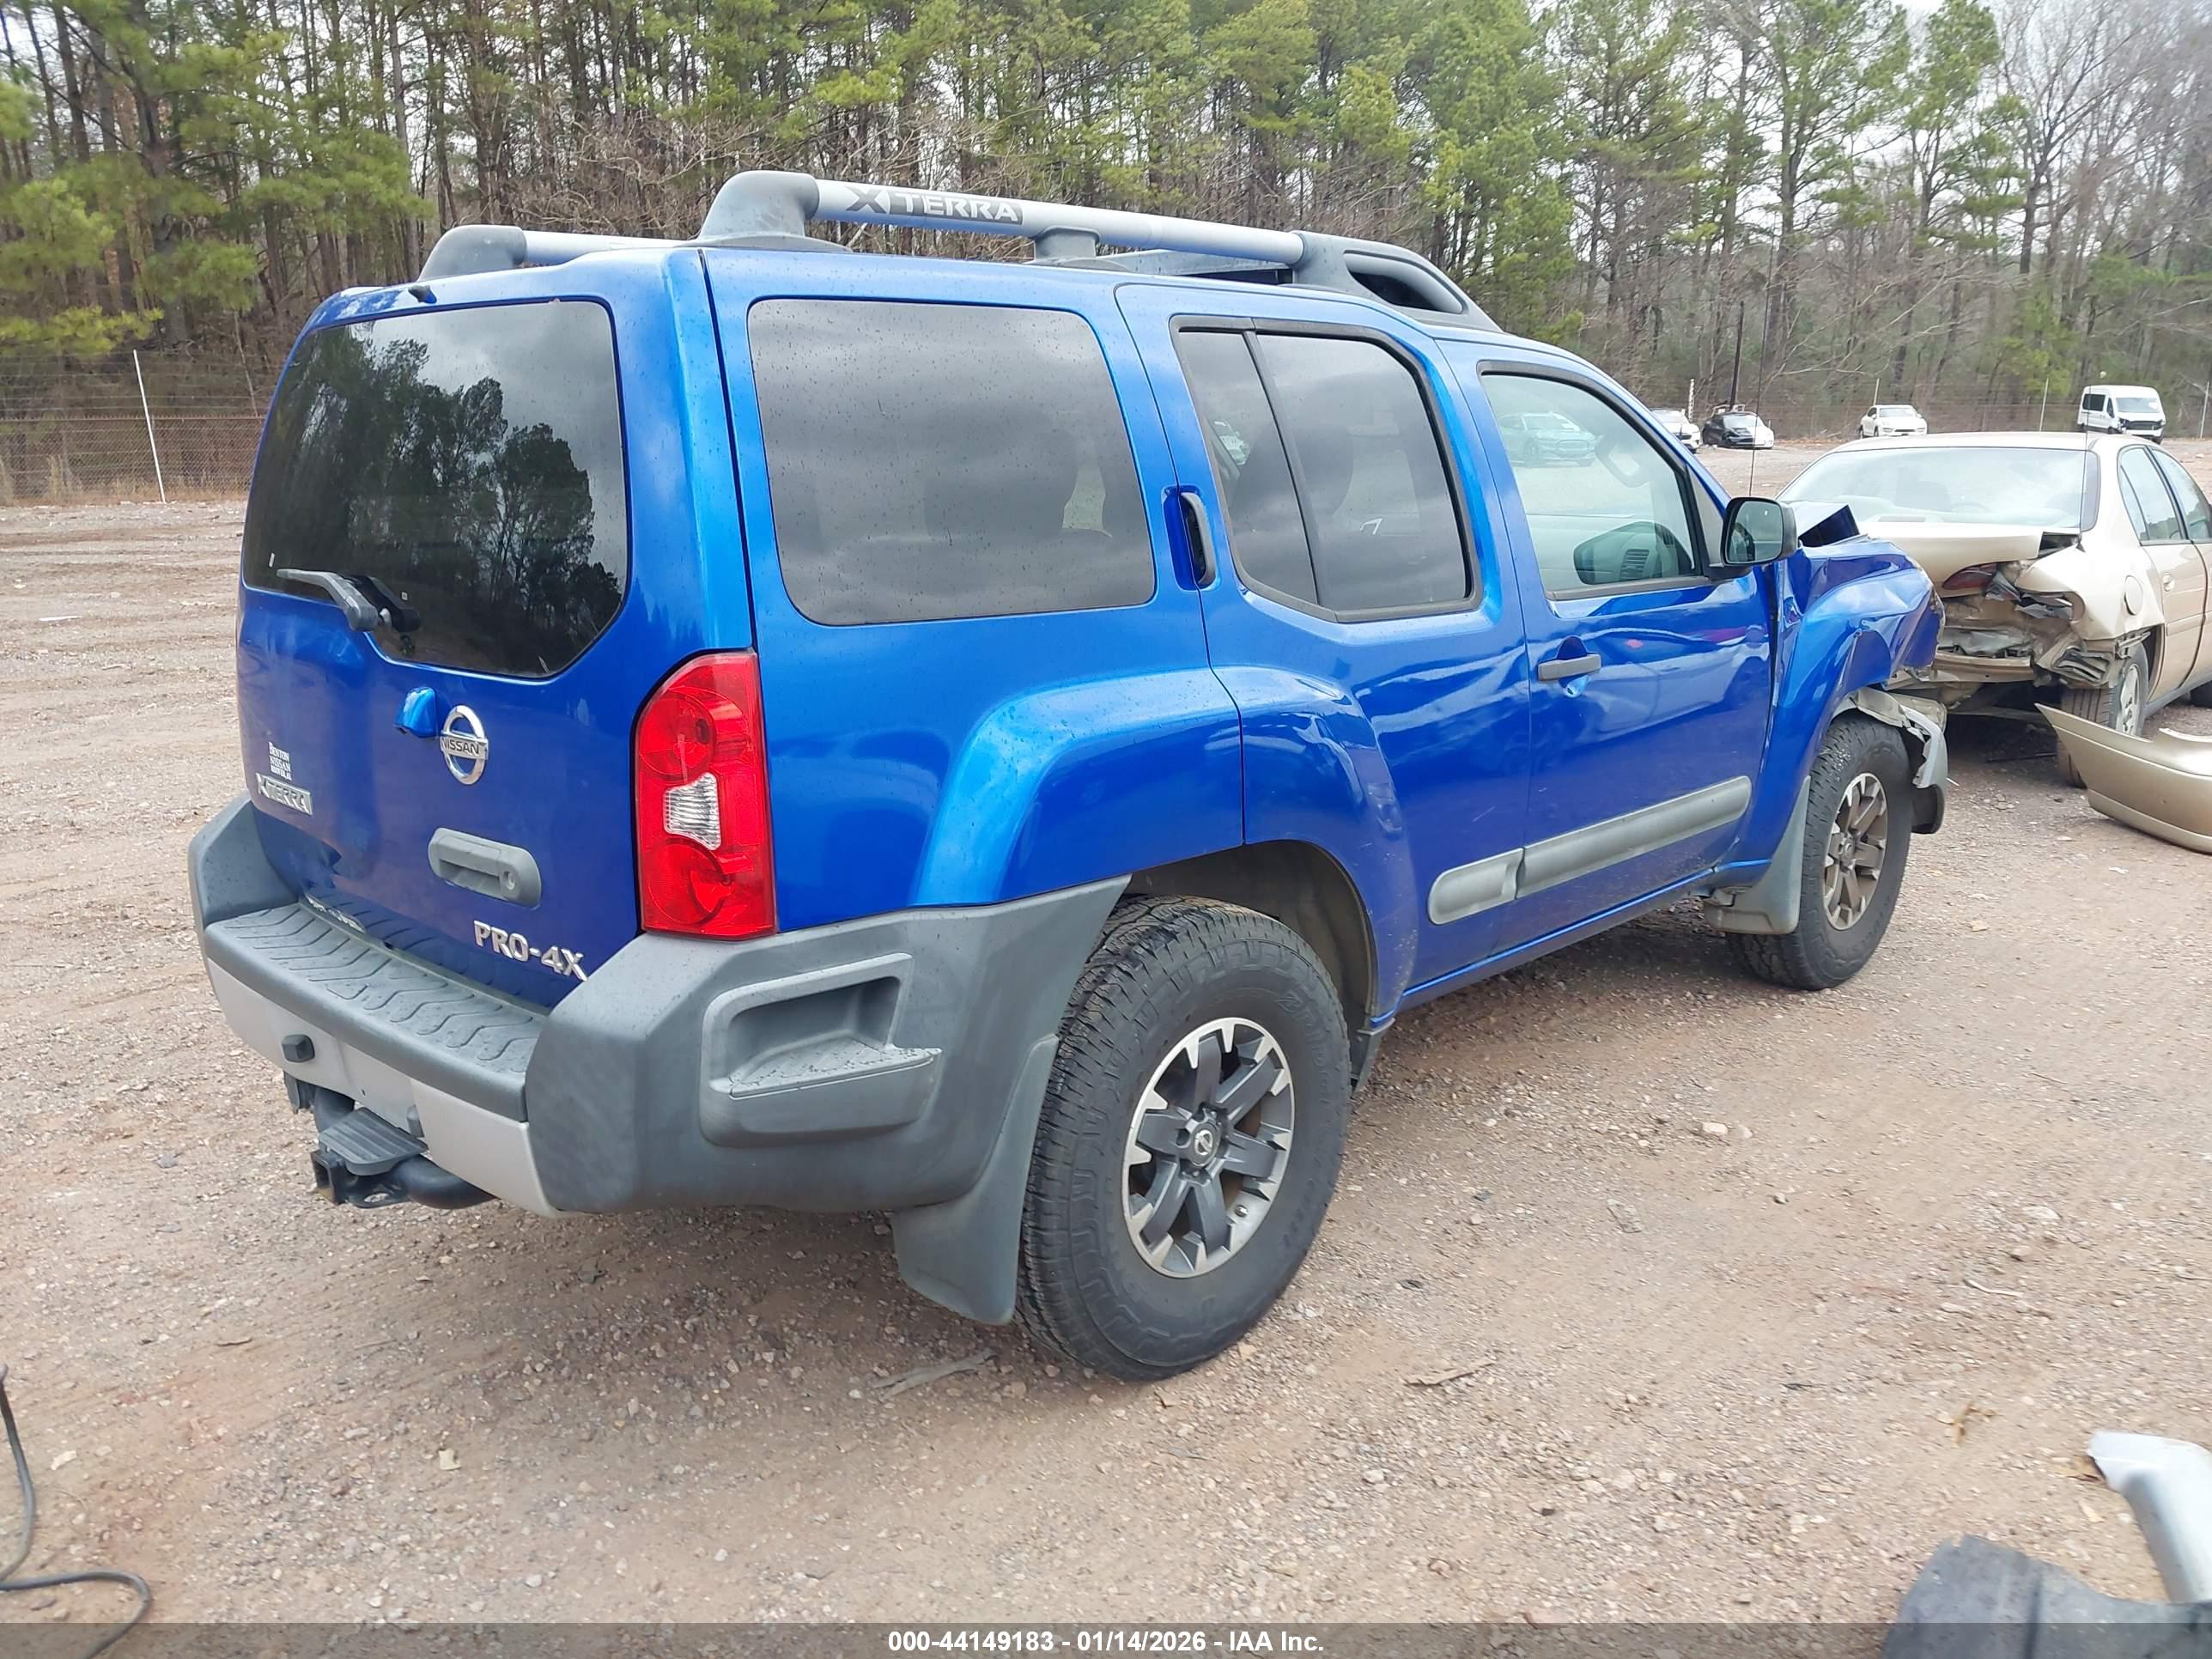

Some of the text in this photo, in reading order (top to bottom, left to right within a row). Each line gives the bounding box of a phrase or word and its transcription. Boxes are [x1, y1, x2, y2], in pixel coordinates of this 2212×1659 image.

[844, 185, 1019, 222] XTERRA
[441, 738, 480, 755] NISSAN
[473, 920, 588, 981] PRO-4X
